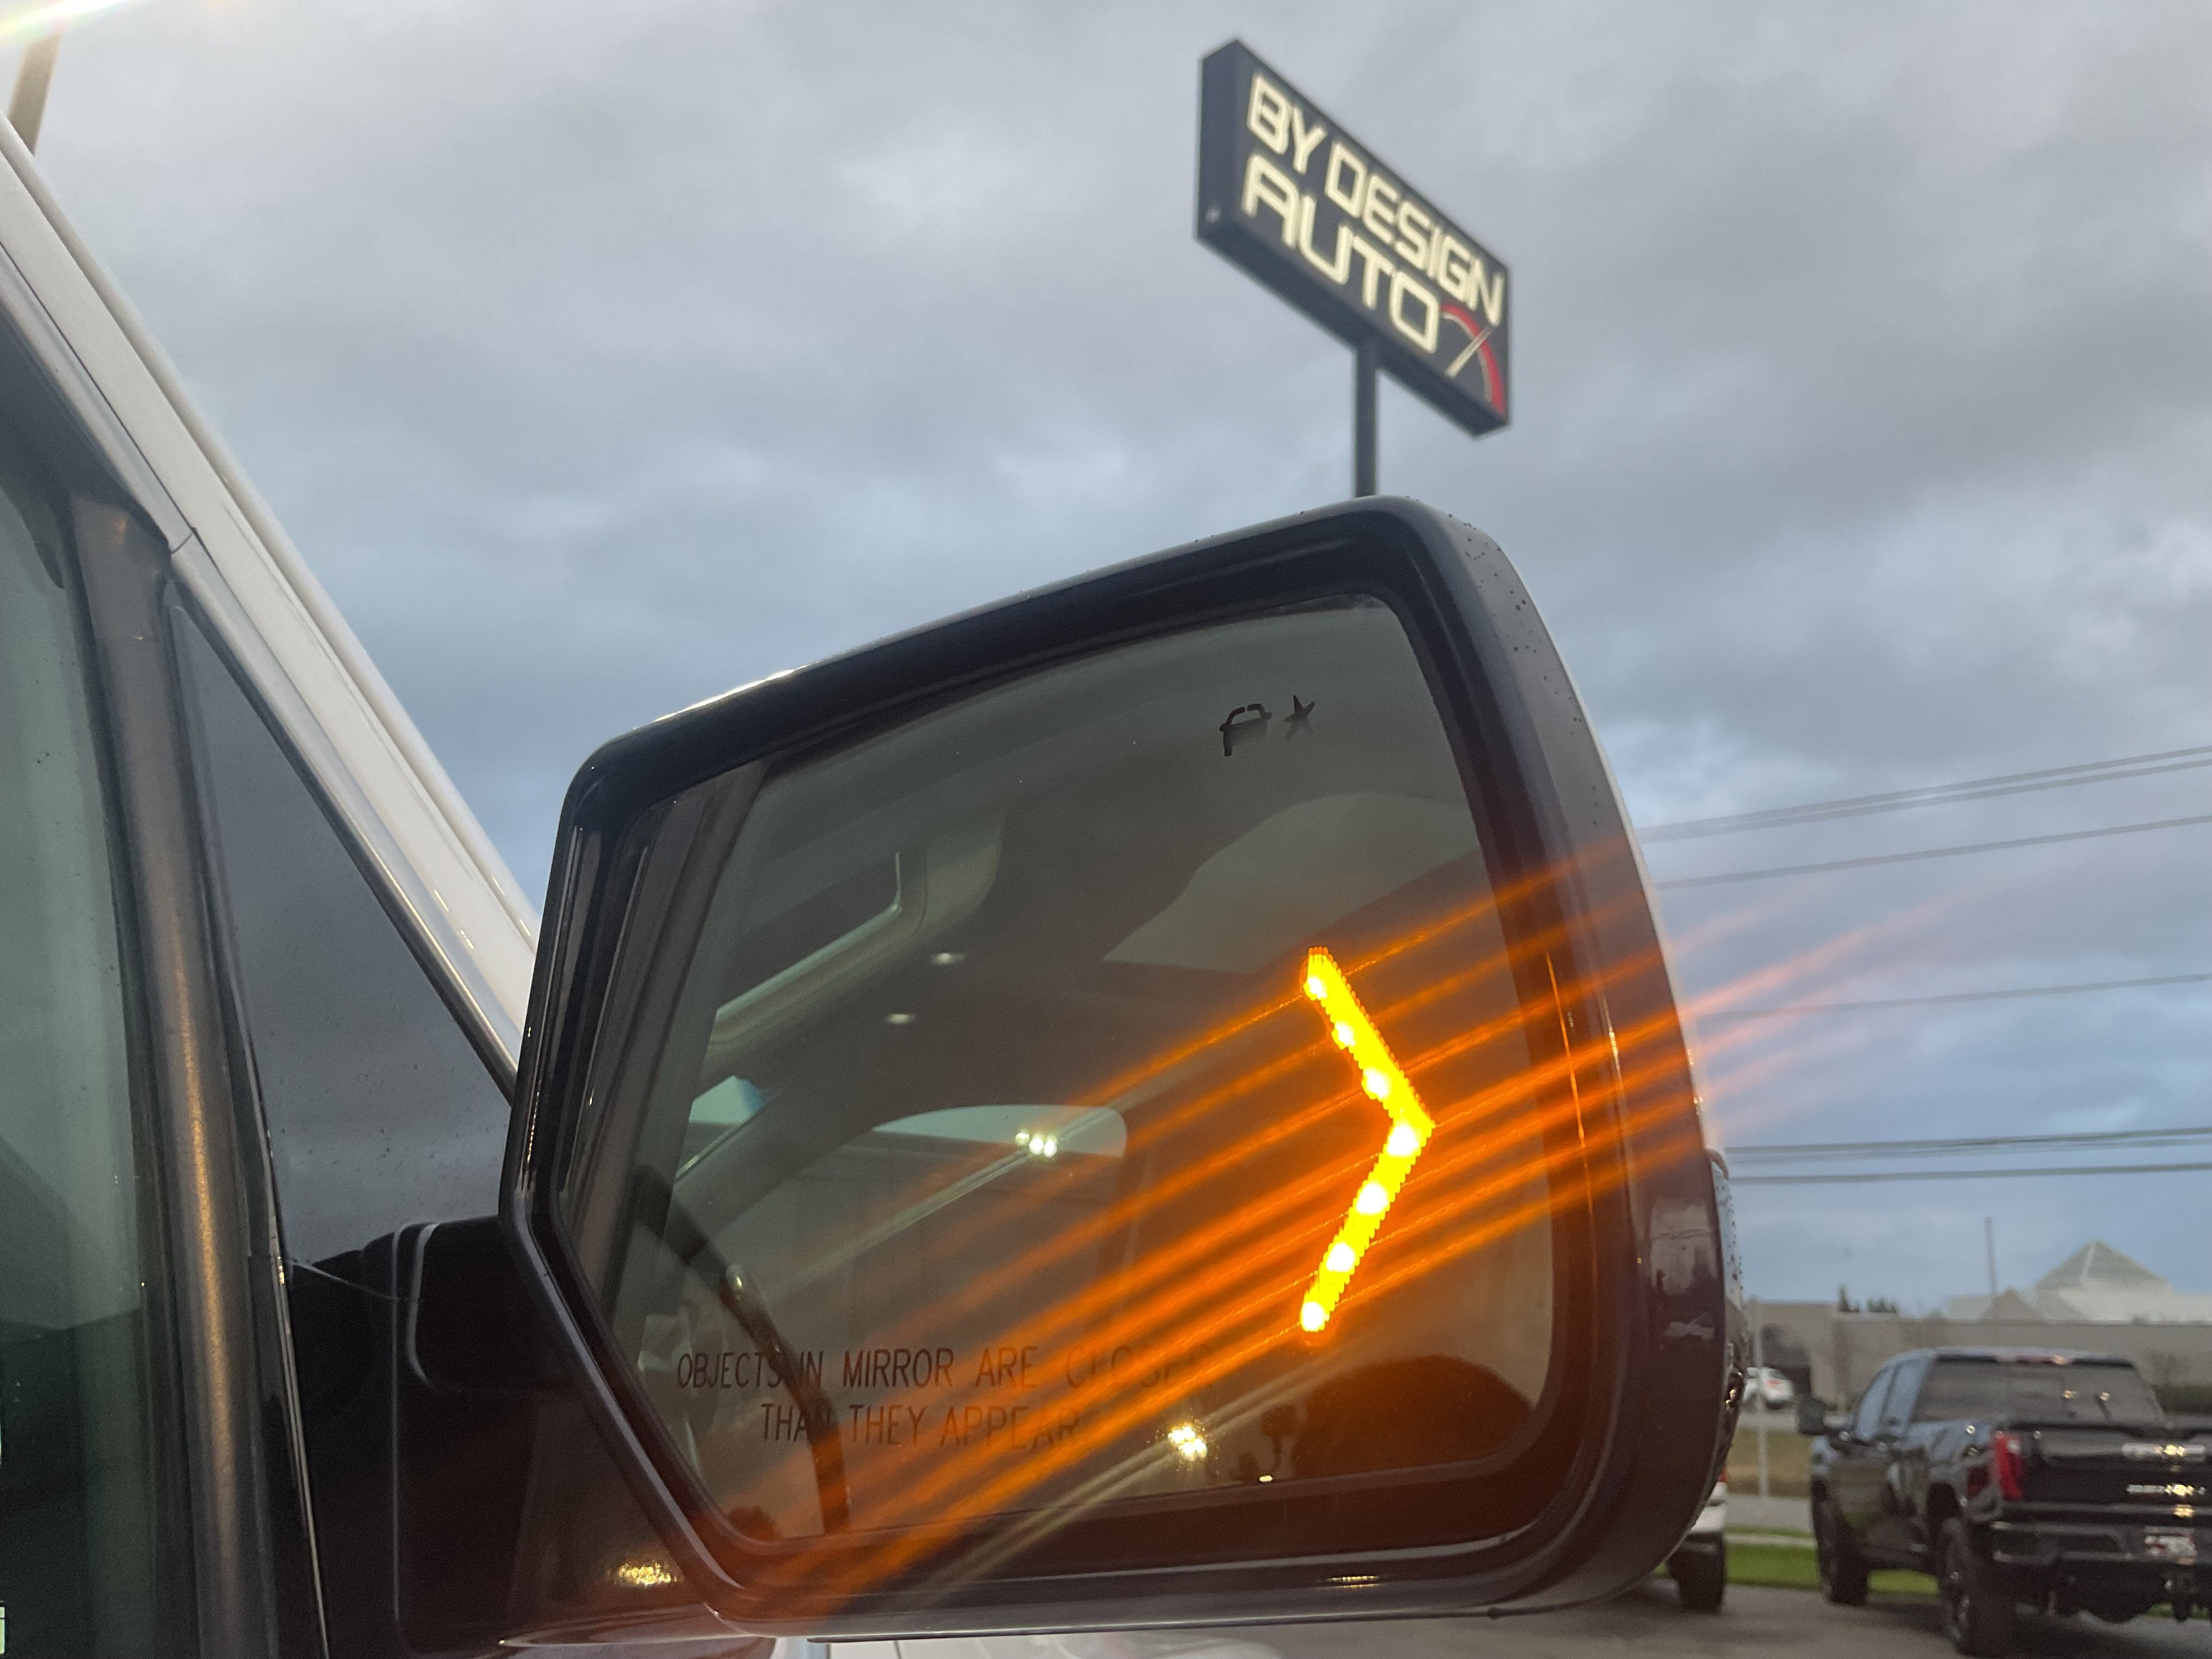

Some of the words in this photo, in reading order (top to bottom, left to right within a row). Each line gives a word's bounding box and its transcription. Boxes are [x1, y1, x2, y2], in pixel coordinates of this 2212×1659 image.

[1240, 154, 1441, 354] AUTO
[1246, 73, 1328, 174] BY
[1324, 142, 1505, 328] DESIGN
[677, 1351, 781, 1388] OBJECTS
[797, 1351, 823, 1388] IN
[843, 1347, 955, 1389] MIRROR
[975, 1346, 1039, 1389] ARE
[849, 1404, 927, 1446] THEY
